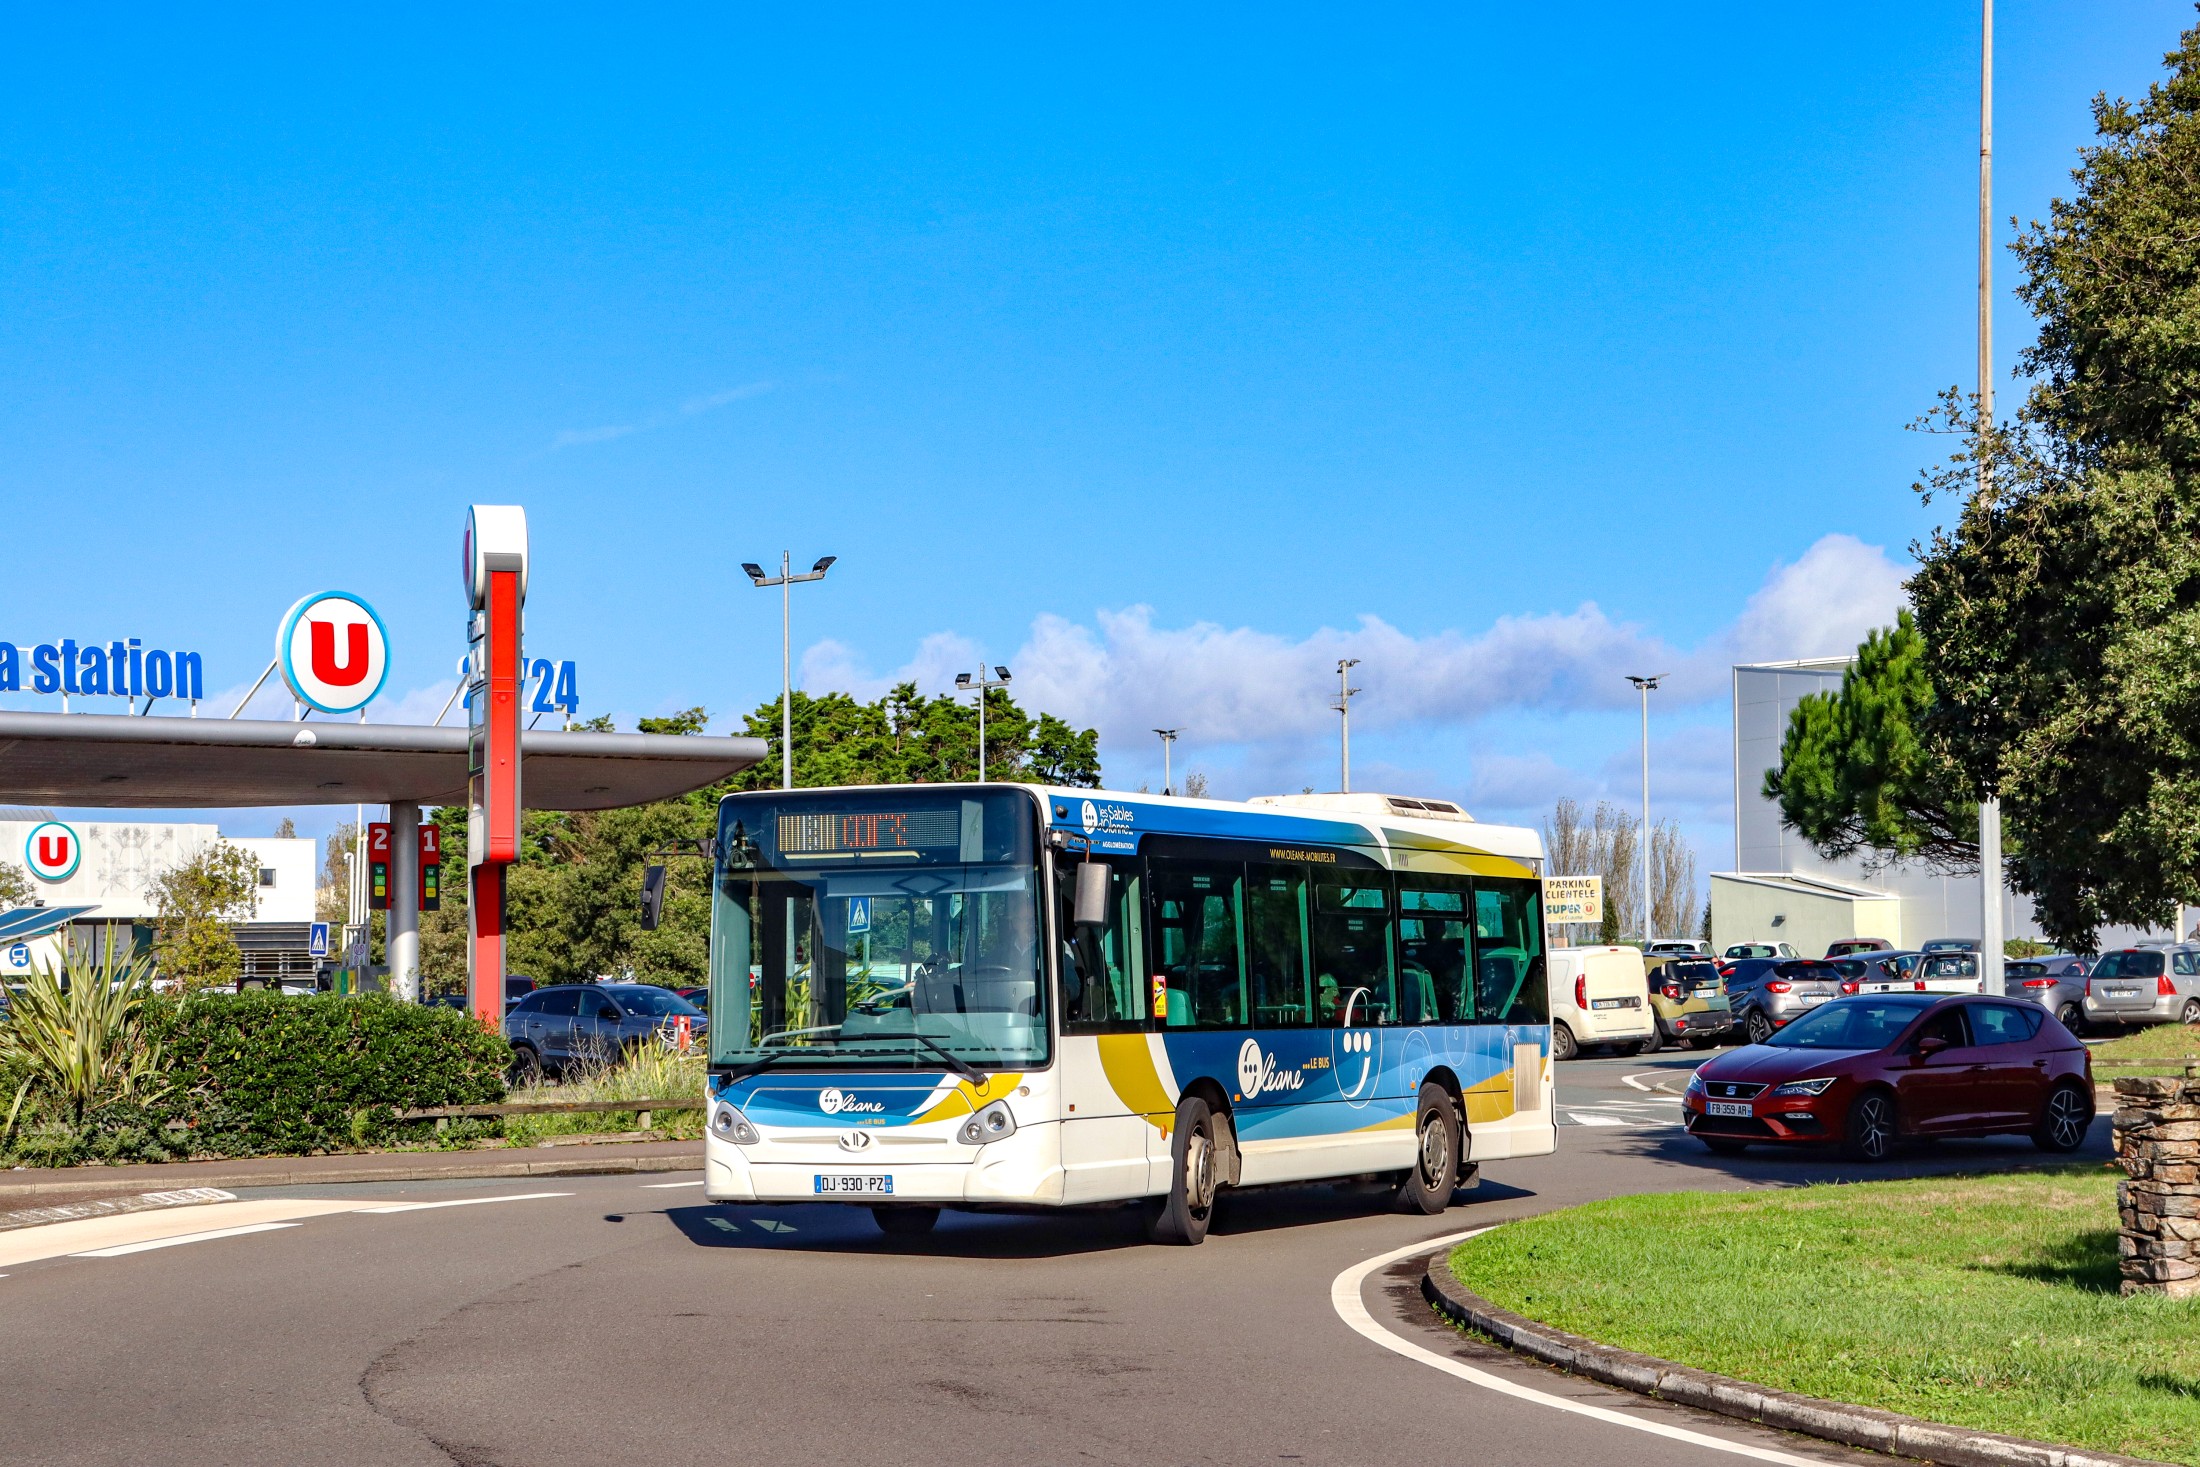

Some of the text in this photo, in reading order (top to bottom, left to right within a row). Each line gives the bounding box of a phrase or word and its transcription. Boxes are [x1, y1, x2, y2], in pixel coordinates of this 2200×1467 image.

[310, 620, 369, 687] U
[29, 637, 203, 700] station
[1108, 804, 1134, 822] Sables
[374, 828, 388, 850] 2
[423, 830, 436, 852] 1
[38, 836, 68, 867] U
[1545, 889, 1595, 899] CLIENTELE
[1549, 879, 1591, 889] PARKING
[1546, 903, 1581, 915] SUPER
[1318, 1056, 1330, 1068] BUS
